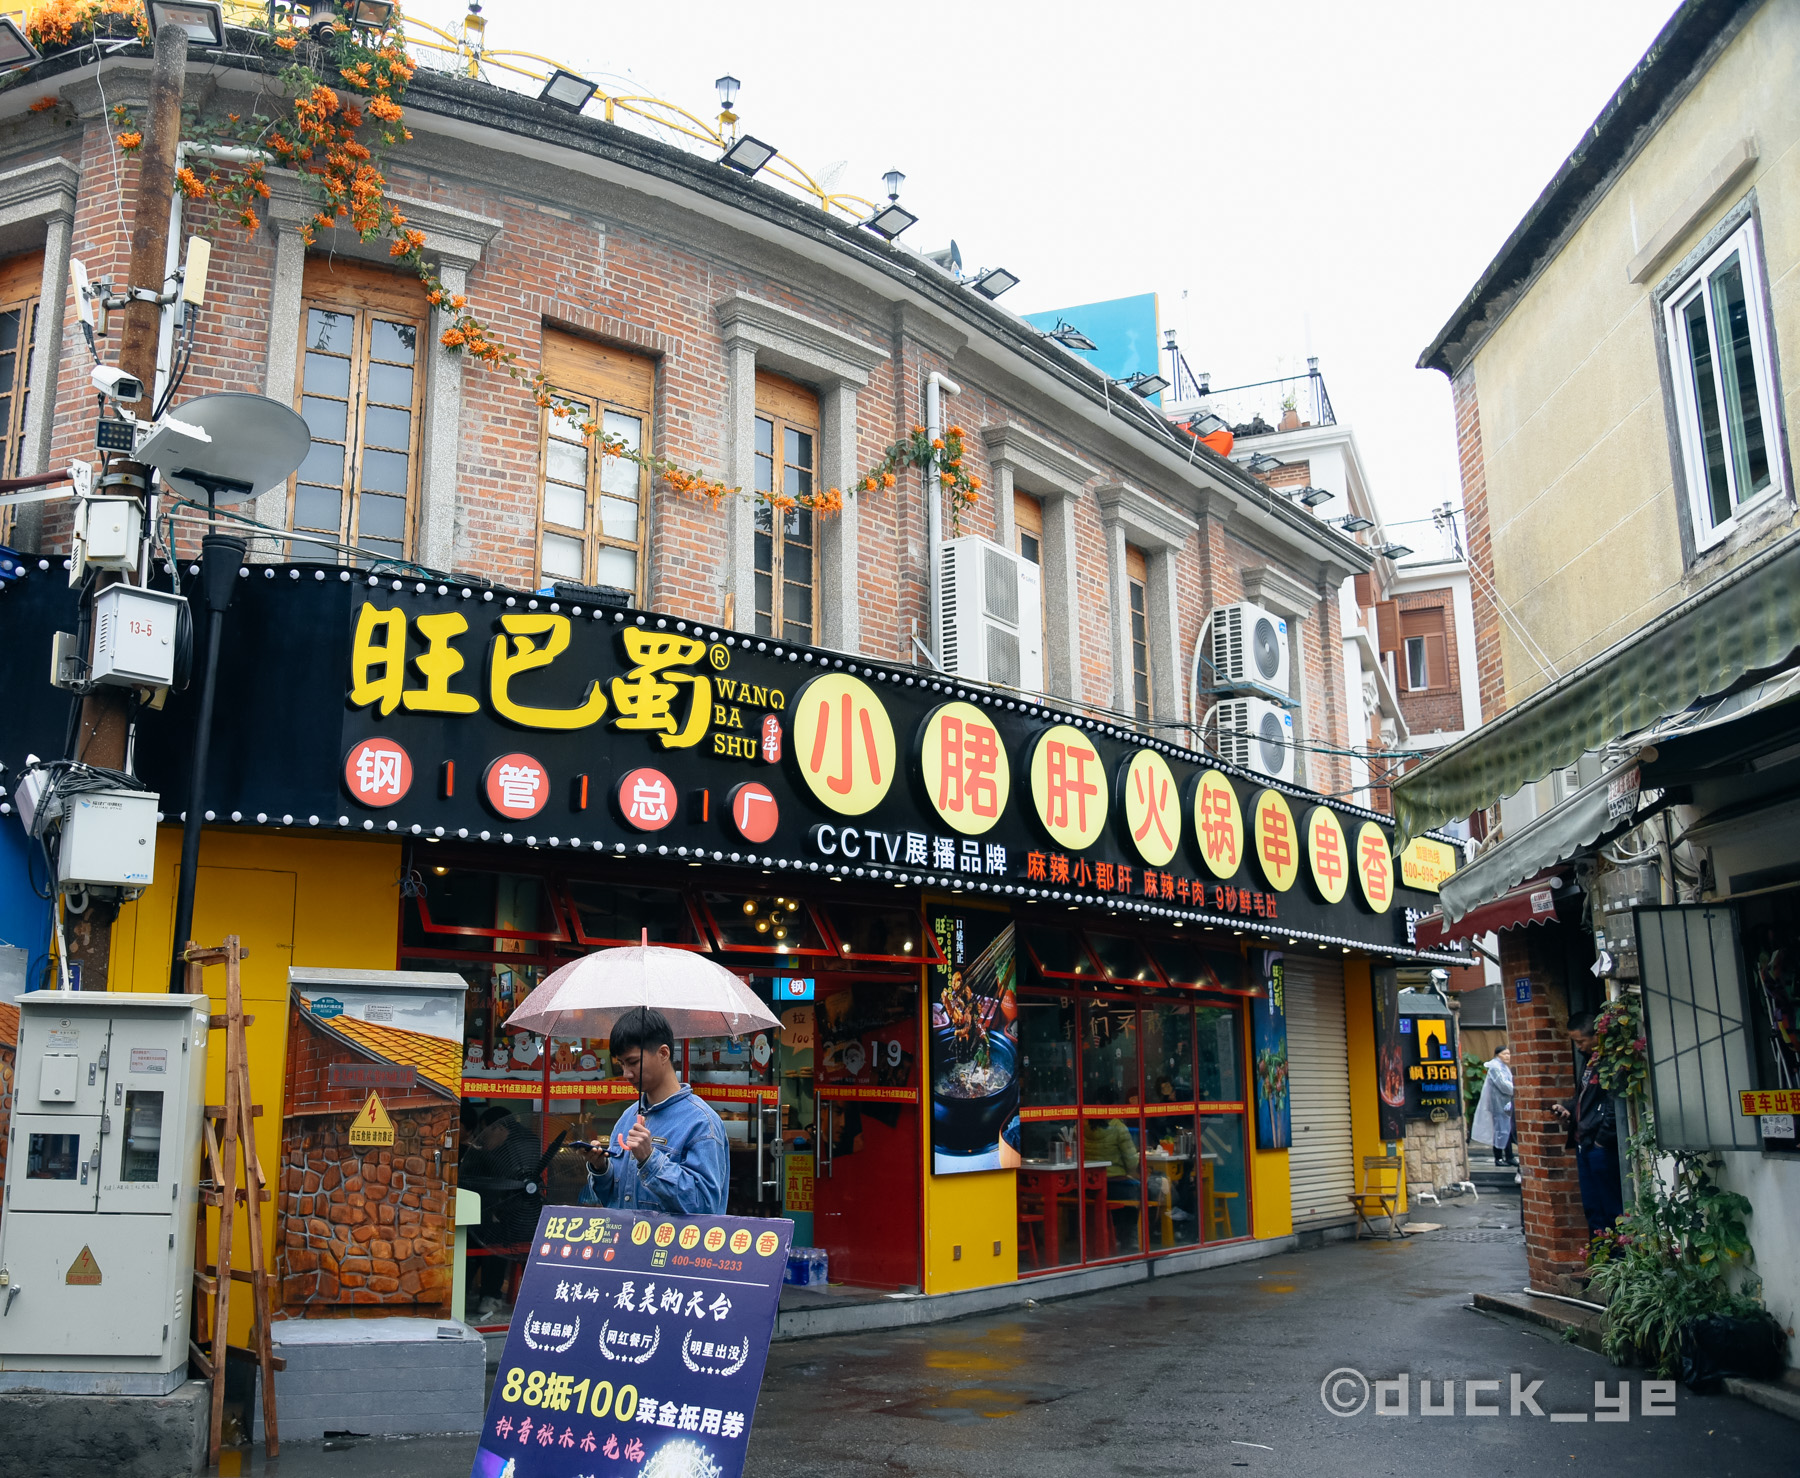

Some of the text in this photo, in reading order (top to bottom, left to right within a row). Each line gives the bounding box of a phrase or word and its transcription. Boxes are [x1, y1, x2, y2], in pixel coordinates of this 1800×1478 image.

[130, 620, 152, 637] 13-5
[350, 602, 711, 748] 旺巴蜀
[714, 704, 744, 728] BA
[714, 733, 757, 759] SHU
[817, 824, 1008, 876] CCTV展播品牌
[1027, 850, 1133, 894] 麻辣小郡肝
[1143, 870, 1205, 906] 麻辣牛肉
[351, 1130, 393, 1143] 高压危险 请勿靠近
[544, 1216, 606, 1244] 旺巴蜀
[671, 1256, 742, 1271] 400-996-3233
[530, 1320, 574, 1339] 连锁品牌
[606, 1330, 653, 1349] 网红餐厅
[689, 1340, 741, 1361] 明星出没
[502, 1367, 744, 1438] 88抵100 菜金抵用券
